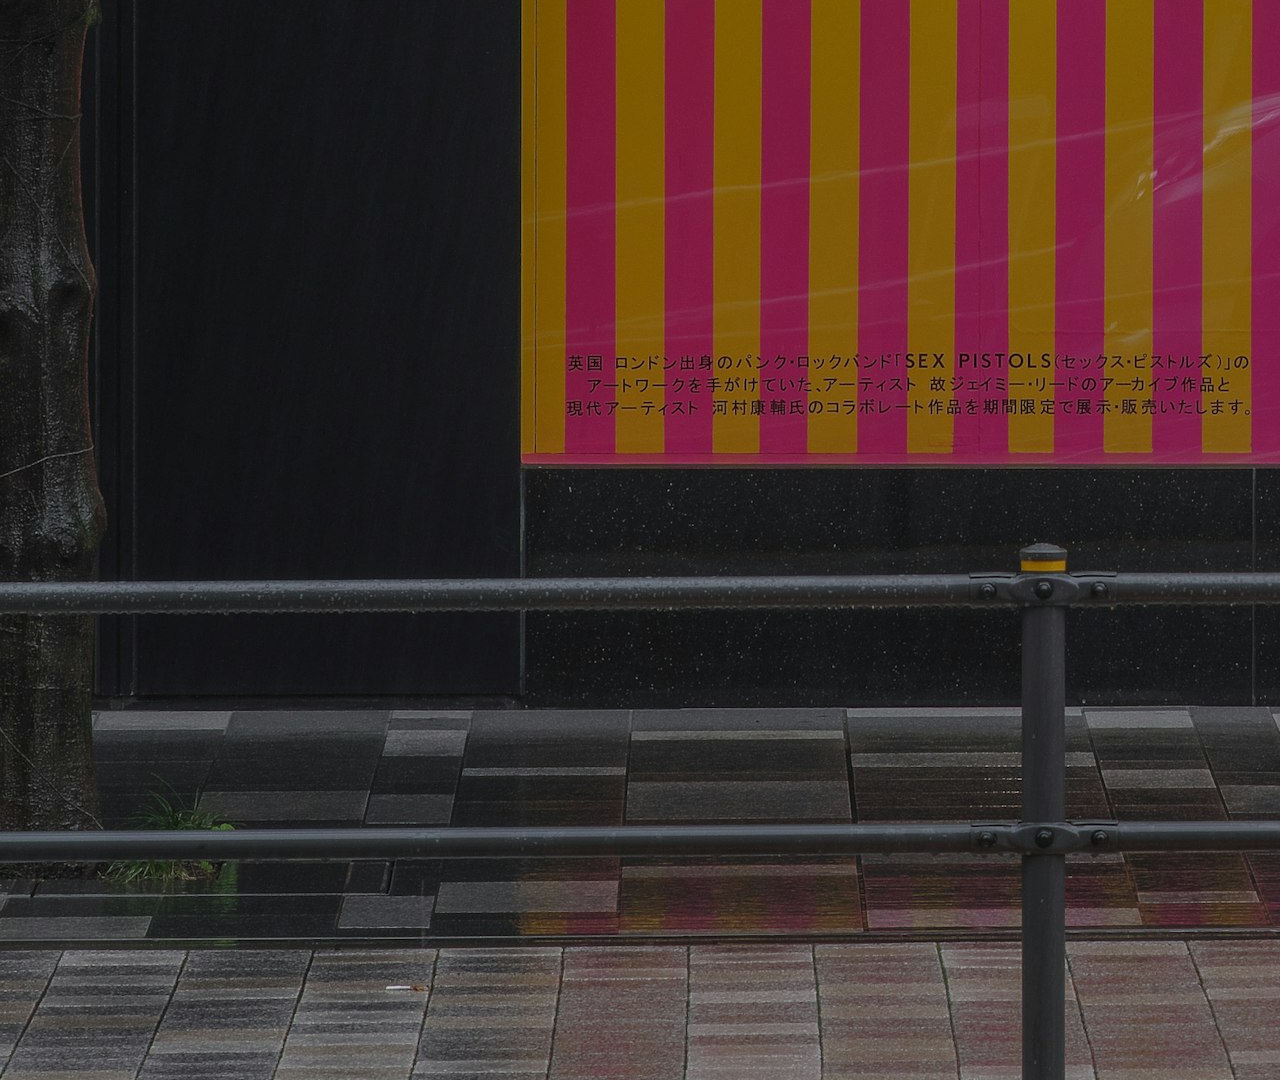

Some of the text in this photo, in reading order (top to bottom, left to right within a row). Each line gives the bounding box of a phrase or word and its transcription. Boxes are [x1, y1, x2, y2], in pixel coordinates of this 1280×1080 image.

[568, 354, 602, 372] 英国
[566, 399, 698, 417] 現代アーティスト
